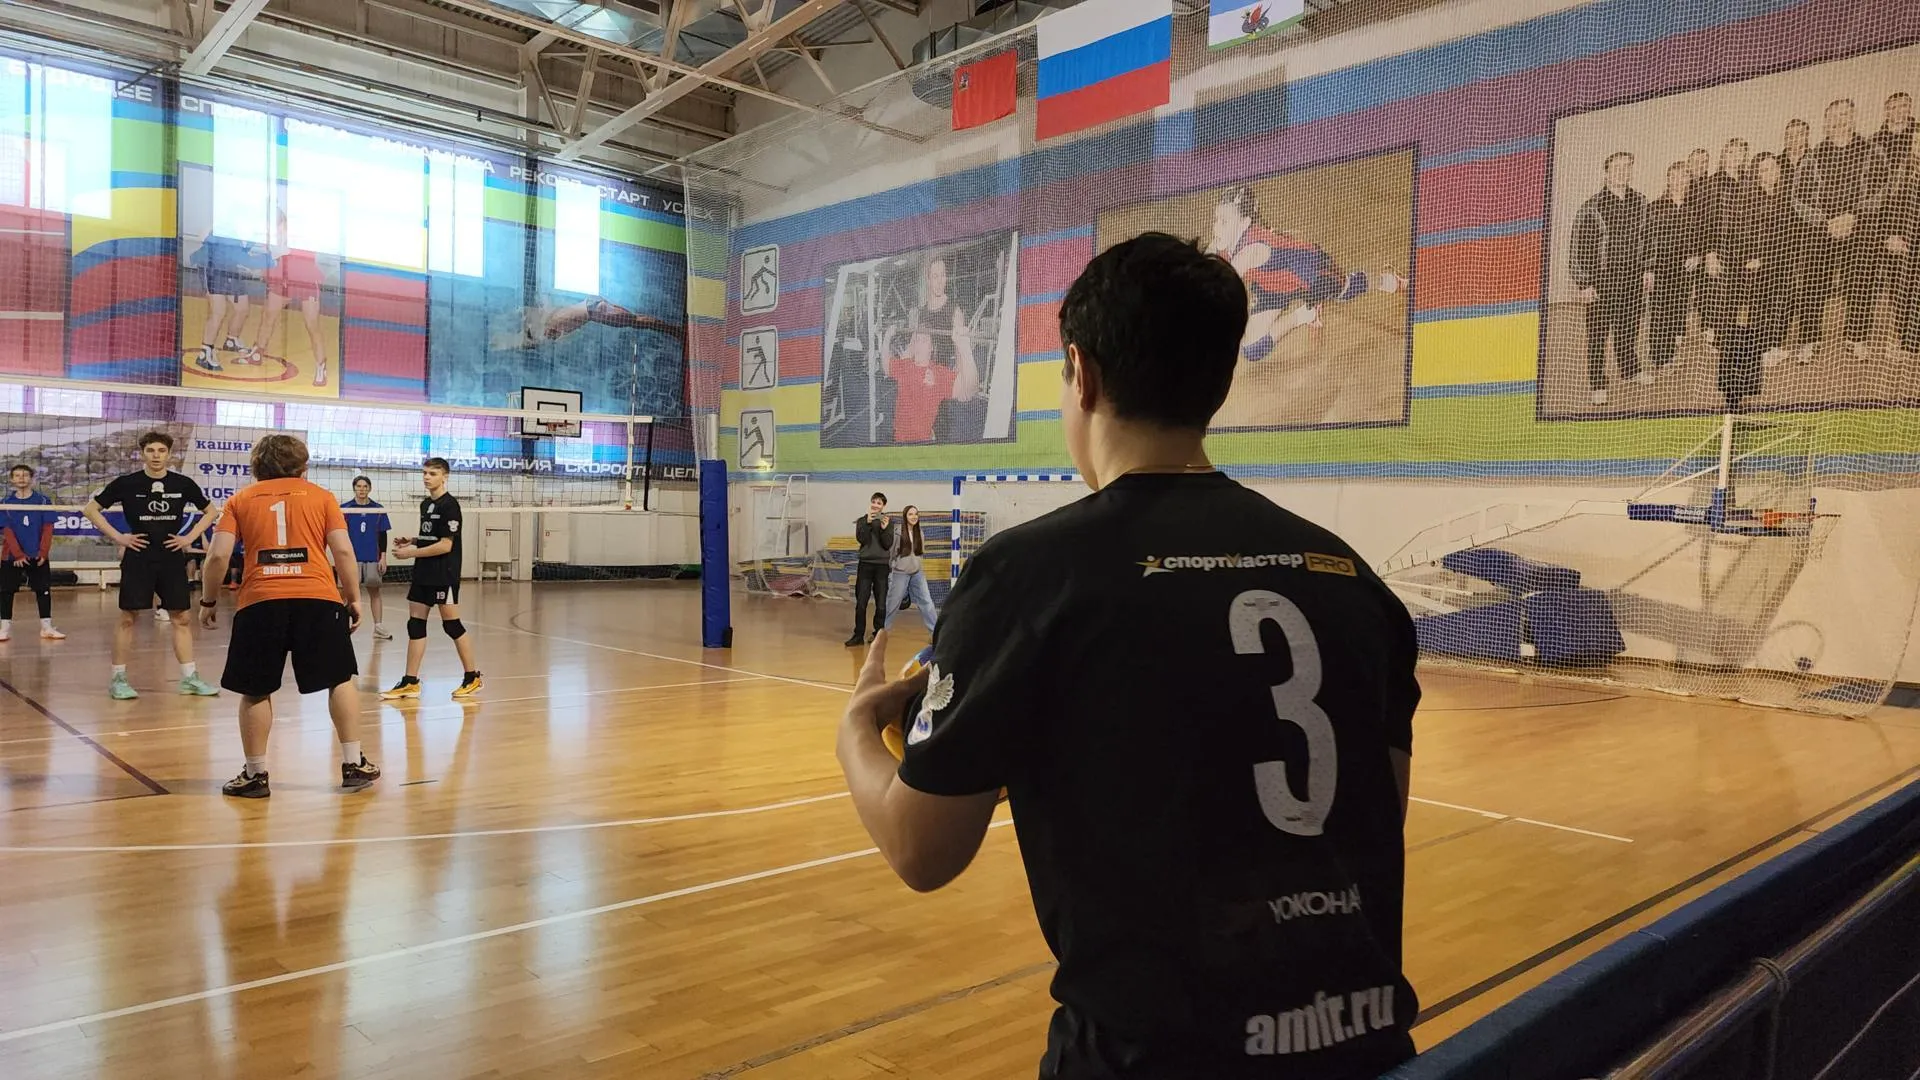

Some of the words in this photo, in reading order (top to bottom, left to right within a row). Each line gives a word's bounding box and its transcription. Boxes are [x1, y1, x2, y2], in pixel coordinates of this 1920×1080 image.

[596, 184, 650, 207] СТАРТ
[196, 440, 252, 452] кашир
[663, 466, 699, 479] ЦЕЛ
[54, 516, 99, 530] 202
[269, 500, 288, 547] 1
[1309, 556, 1351, 573] PRO
[1229, 589, 1338, 836] 3
[1267, 883, 1361, 924] YOKOHA
[1244, 985, 1396, 1056] amfr.ru
